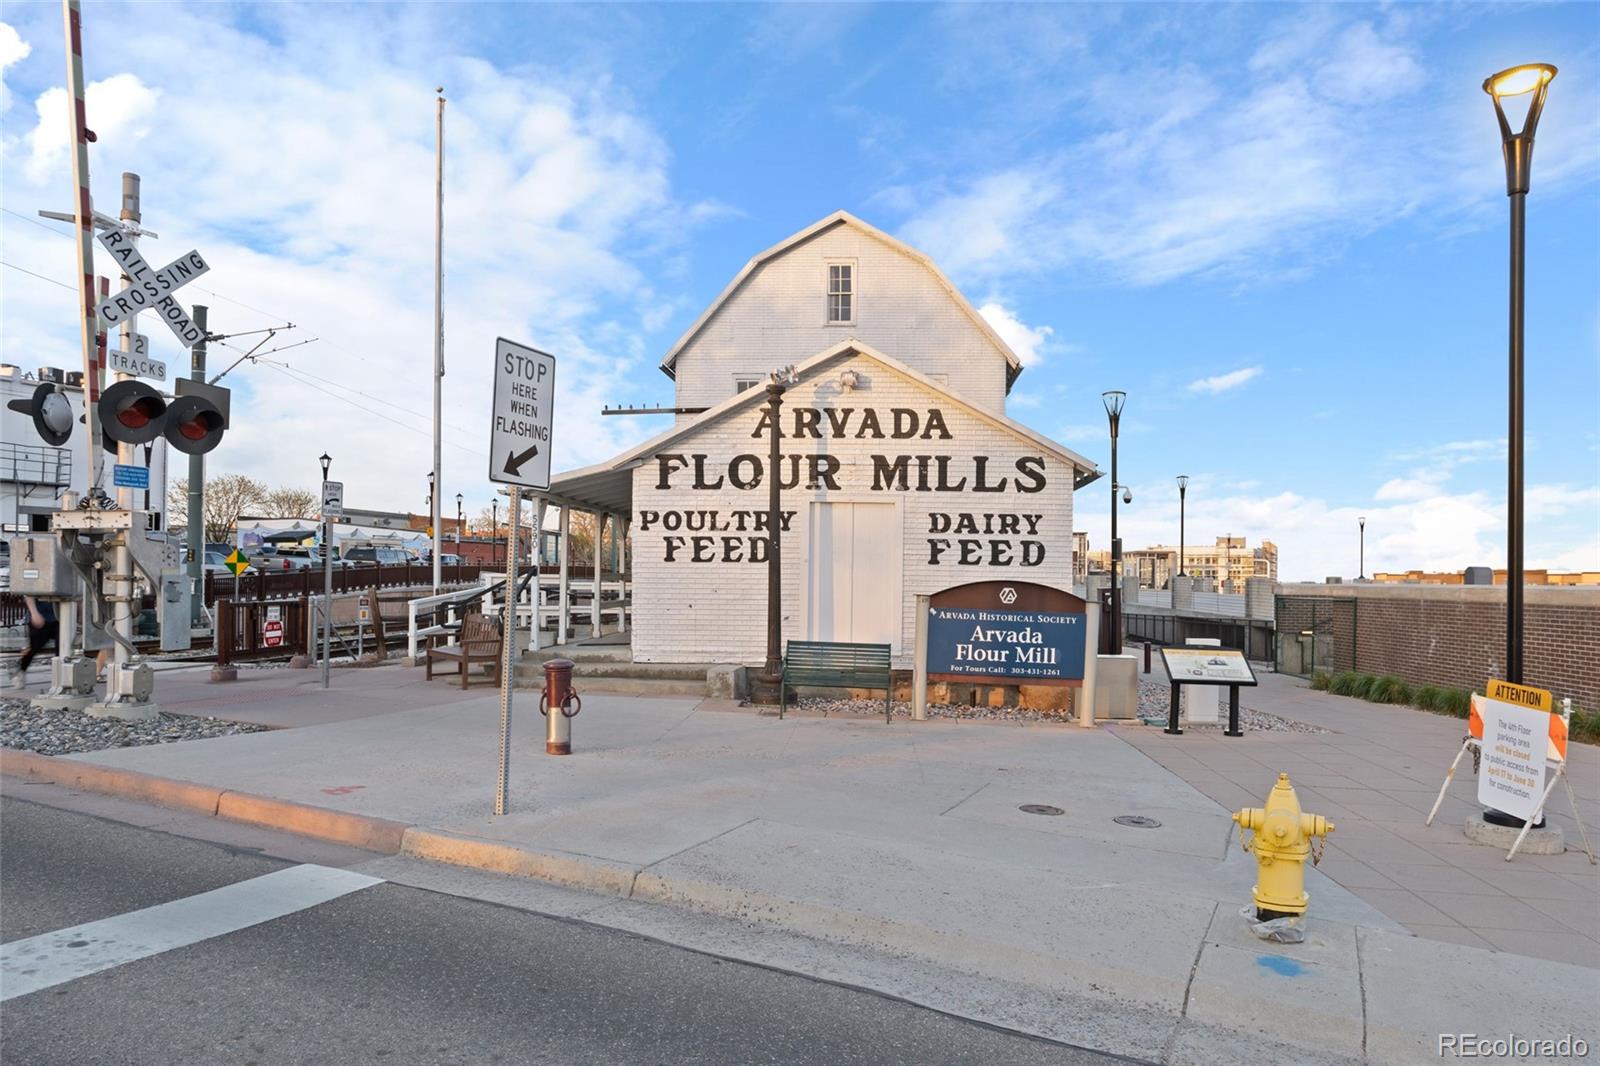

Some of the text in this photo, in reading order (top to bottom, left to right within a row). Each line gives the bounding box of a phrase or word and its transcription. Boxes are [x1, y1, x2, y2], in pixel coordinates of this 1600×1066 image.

[102, 254, 204, 322] CROSSING
[135, 338, 144, 354] 2
[112, 354, 164, 377] TRACKS
[504, 353, 547, 383] STOP
[512, 381, 537, 401] HERE
[510, 400, 538, 418] WHEN
[496, 416, 548, 442] FLASHING
[751, 408, 953, 440] ARVADA
[654, 453, 1047, 494] FLOUR MILLS
[639, 510, 798, 532] POULTRY
[928, 512, 1044, 535] DAIRY
[663, 536, 770, 563] FEED
[927, 538, 1046, 567] FEED
[938, 610, 1077, 625] ARVADA HISTORICAL SOCIETY
[970, 625, 1043, 645] Arvada
[955, 643, 1057, 665] Flour Mill
[950, 664, 1061, 676] For Tours Call: 303-431-1261
[1495, 684, 1542, 707] ATTENTION
[1498, 719, 1507, 729] The
[1518, 724, 1532, 735] Floor
[1497, 733, 1530, 748] parking area
[1488, 765, 1500, 776] April
[1490, 755, 1506, 766] public
[1506, 761, 1525, 772] access
[1525, 765, 1539, 776] from
